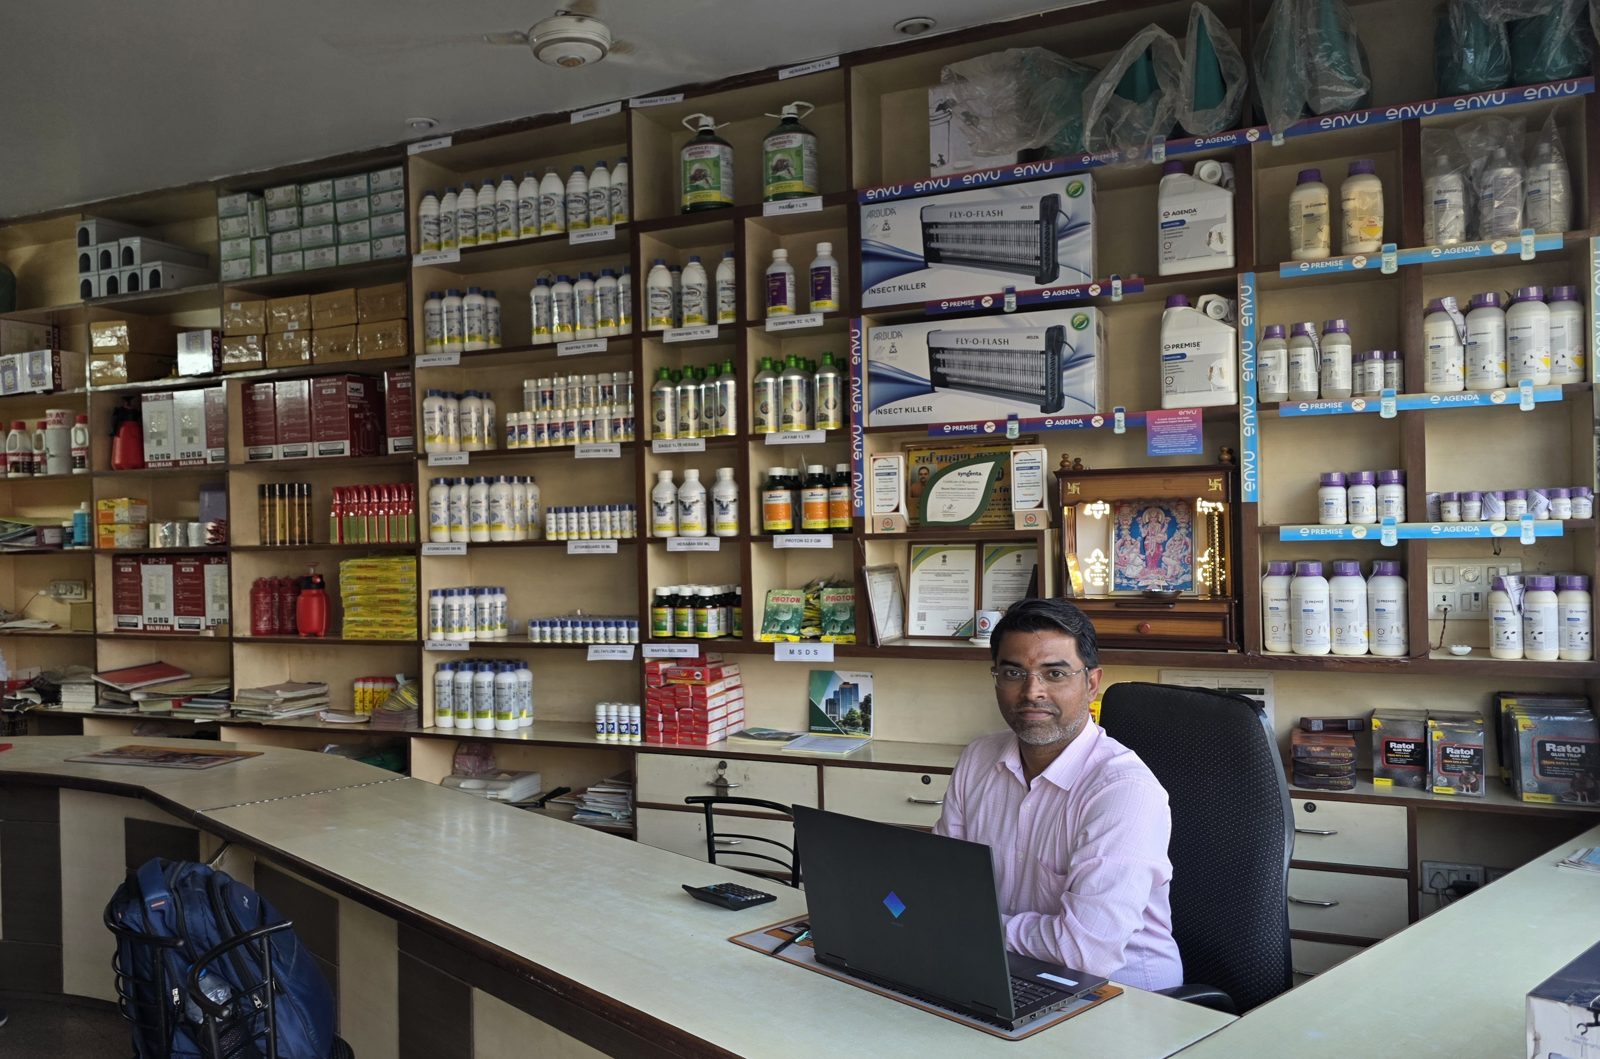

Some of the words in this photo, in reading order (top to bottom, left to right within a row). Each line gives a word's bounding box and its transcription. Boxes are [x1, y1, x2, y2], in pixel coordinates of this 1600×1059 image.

[1524, 82, 1577, 100] envu
[1454, 92, 1505, 110] envu
[1386, 102, 1436, 120] envu
[1320, 112, 1369, 128] envu
[1205, 134, 1237, 145] AGENDA
[1014, 162, 1054, 177] envu
[962, 170, 1001, 185] envu
[914, 178, 950, 193] envu
[866, 188, 902, 200] envu
[950, 209, 1004, 219] FLY-O-FLASH
[1172, 208, 1197, 216] AGENDA
[1444, 246, 1480, 255] AGENDA
[1310, 260, 1343, 270] PREMISE
[868, 285, 897, 295] INSECT
[898, 282, 926, 292] KILLER
[1052, 288, 1081, 297] AGENDA
[949, 299, 976, 308] PREMISE
[1243, 285, 1252, 327] envu
[956, 336, 1010, 345] FLY-O-FLASH
[1172, 342, 1201, 350] PREMISE
[852, 329, 861, 365] envu
[1244, 340, 1253, 380] envu
[852, 377, 861, 413] envu
[1442, 394, 1480, 403] AGENDA
[875, 407, 903, 415] INSECT
[905, 406, 933, 414] KILLER
[1310, 401, 1343, 410] PREMISE
[1244, 396, 1253, 437] envu
[951, 423, 978, 432] PREMISE
[1054, 418, 1083, 427] AGENDA
[853, 425, 862, 460] envu
[1244, 452, 1255, 492] envu
[853, 472, 862, 508] envu
[1311, 528, 1343, 536] PREMISE
[1443, 526, 1479, 534] AGENDA
[825, 594, 856, 603] PROTON
[1446, 747, 1474, 755] Ratol
[1545, 743, 1586, 754] Ratol
